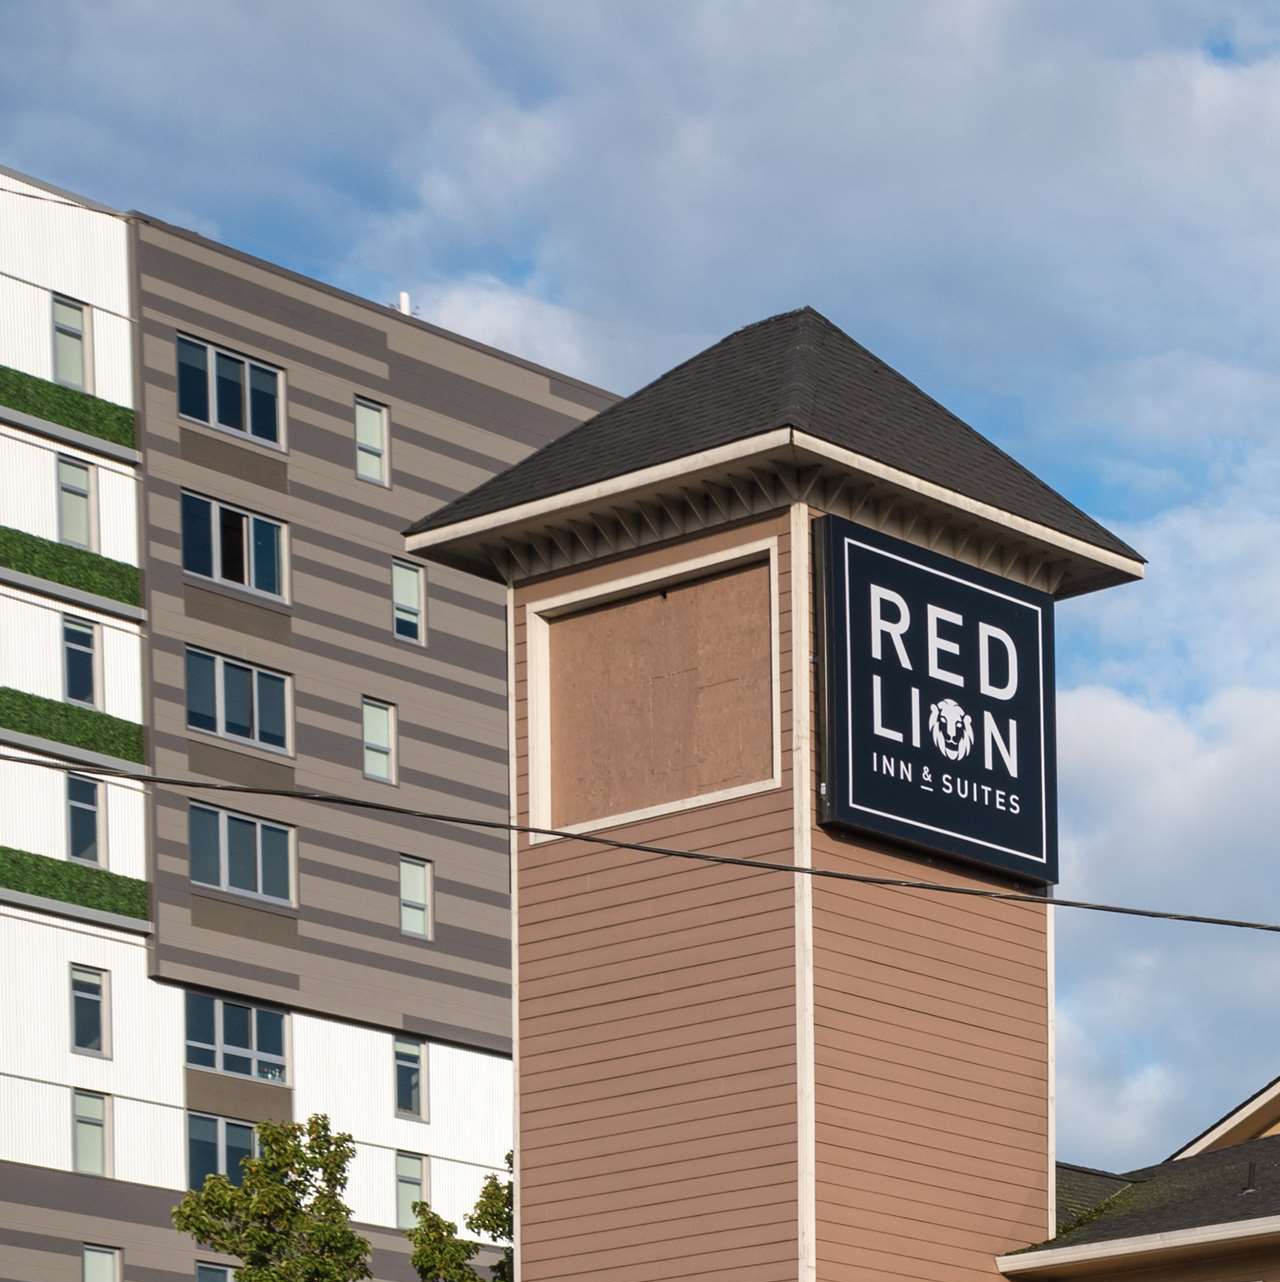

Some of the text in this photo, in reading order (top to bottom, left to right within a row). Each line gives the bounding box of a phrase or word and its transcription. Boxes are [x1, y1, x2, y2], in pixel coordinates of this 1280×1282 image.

[869, 583, 1019, 701] RED
[872, 752, 1021, 815] INN & SUITES
